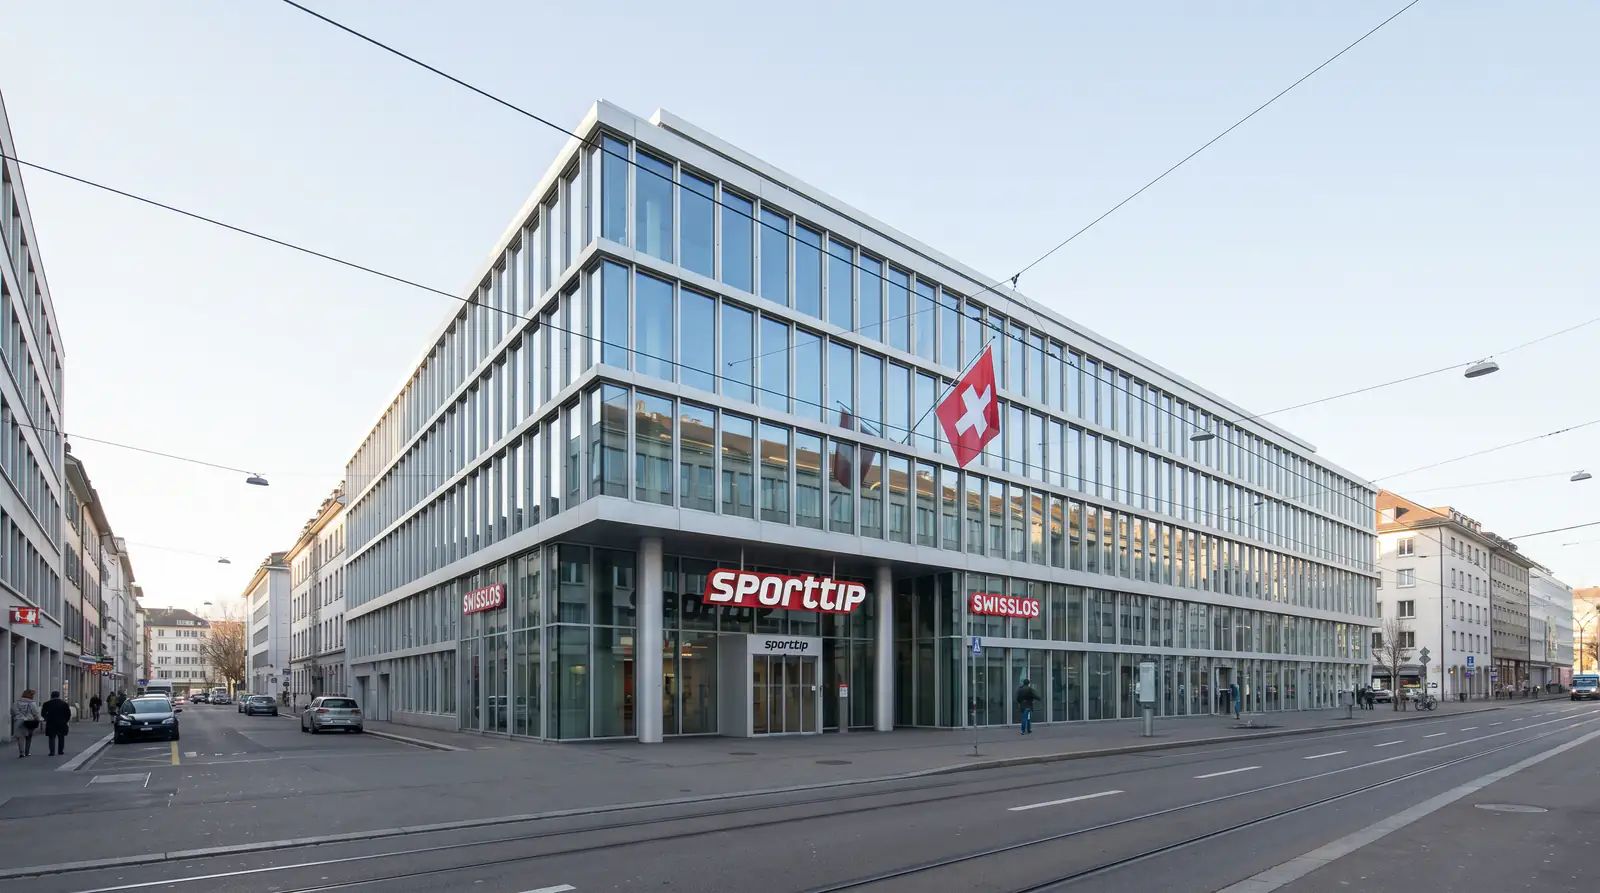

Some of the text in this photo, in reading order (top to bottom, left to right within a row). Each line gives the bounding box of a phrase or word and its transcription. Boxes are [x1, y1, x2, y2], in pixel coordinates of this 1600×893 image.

[463, 585, 501, 612] SWISSLOS
[973, 594, 1039, 616] SWISSLOS
[765, 640, 808, 651] sporttip
